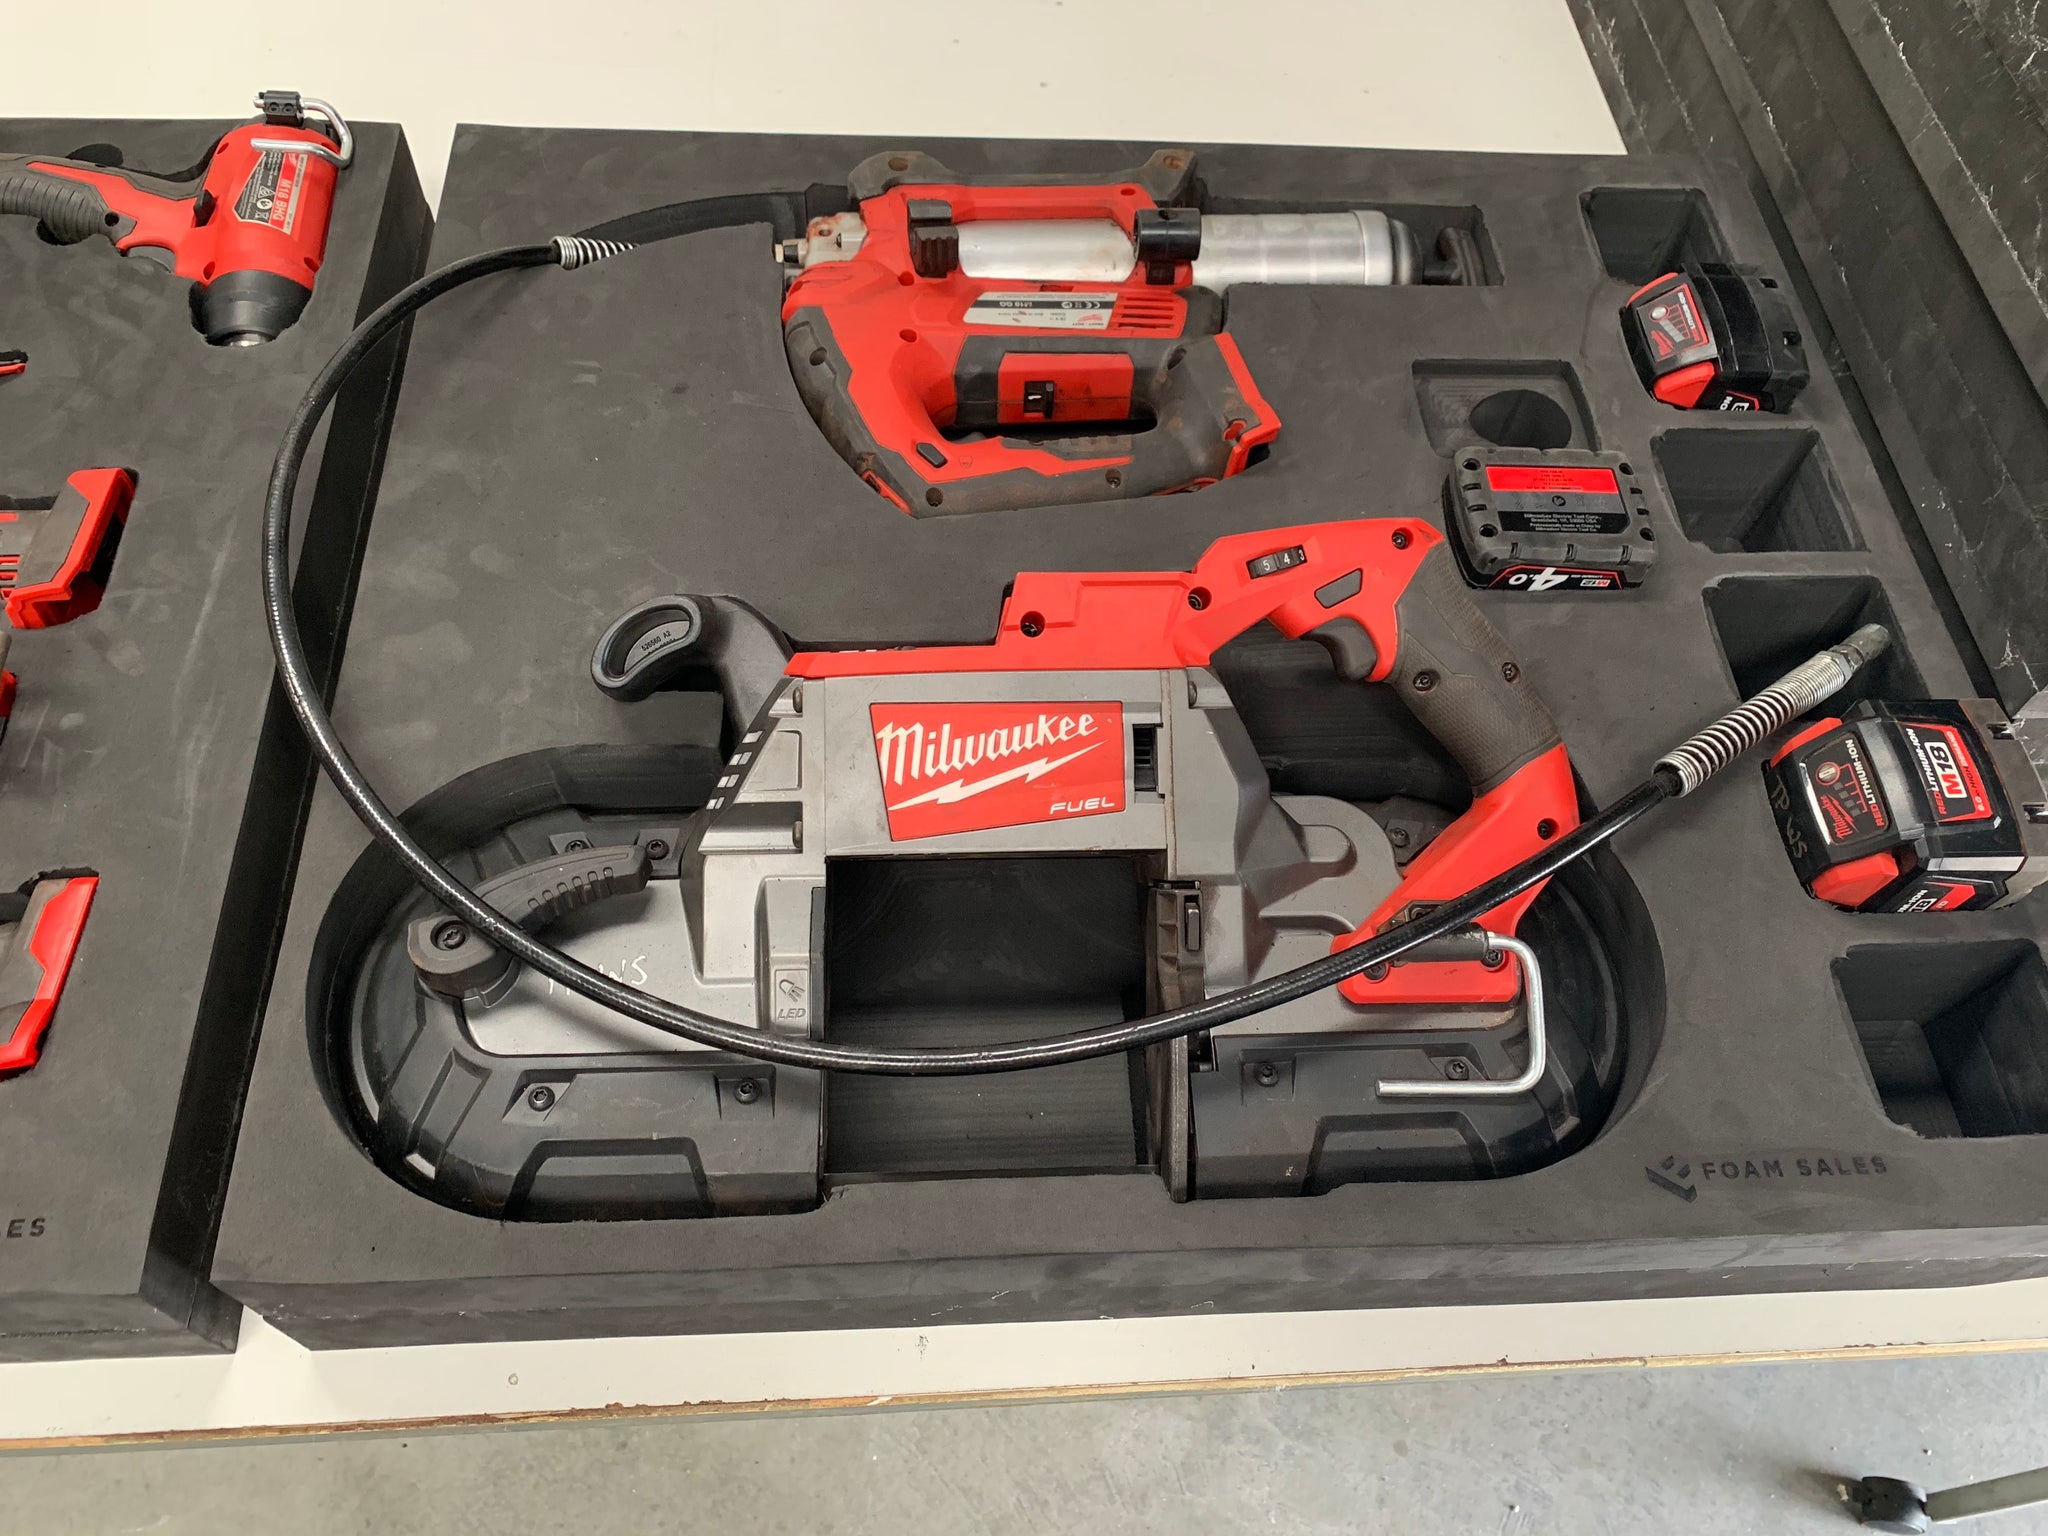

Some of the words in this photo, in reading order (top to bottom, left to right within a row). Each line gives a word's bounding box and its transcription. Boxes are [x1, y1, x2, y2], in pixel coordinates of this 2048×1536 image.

[278, 178, 293, 199] M18
[272, 201, 287, 221] BHG
[1262, 560, 1271, 571] 5
[1283, 553, 1291, 565] 4
[1508, 567, 1570, 591] 4.0
[876, 713, 1098, 787] Milwaukee
[1906, 728, 1947, 814] REDLITHIUM-ION
[1929, 745, 1963, 795] M18
[1845, 739, 1885, 826] REDLITHIUM-ION
[1050, 797, 1115, 815] FUEL
[777, 1008, 807, 1020] LED
[1701, 1159, 1785, 1181] FOAM
[1795, 1155, 1888, 1176] SALES
